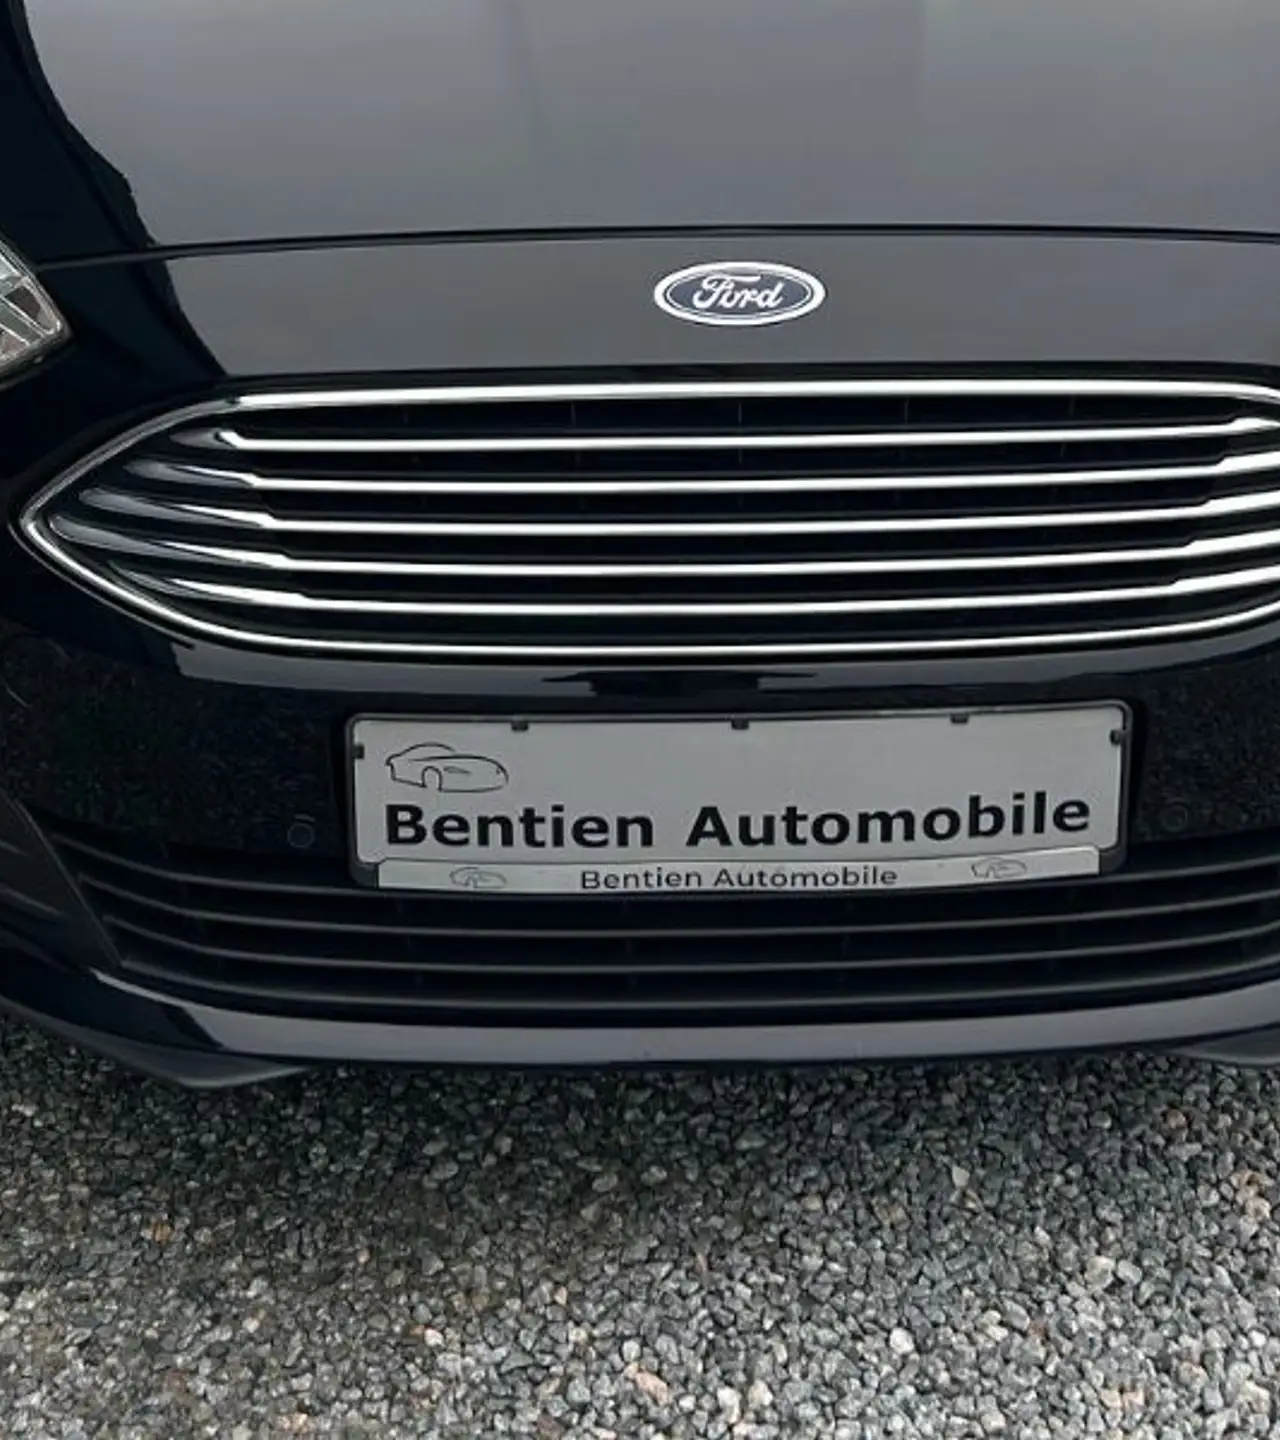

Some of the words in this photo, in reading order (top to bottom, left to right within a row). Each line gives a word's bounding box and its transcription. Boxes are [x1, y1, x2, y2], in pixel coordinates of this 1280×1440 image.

[692, 274, 785, 309] Ford
[385, 803, 654, 849] Bentien
[685, 790, 1091, 848] Automobile
[580, 866, 703, 890] Bentien
[713, 863, 899, 888] Automobile
